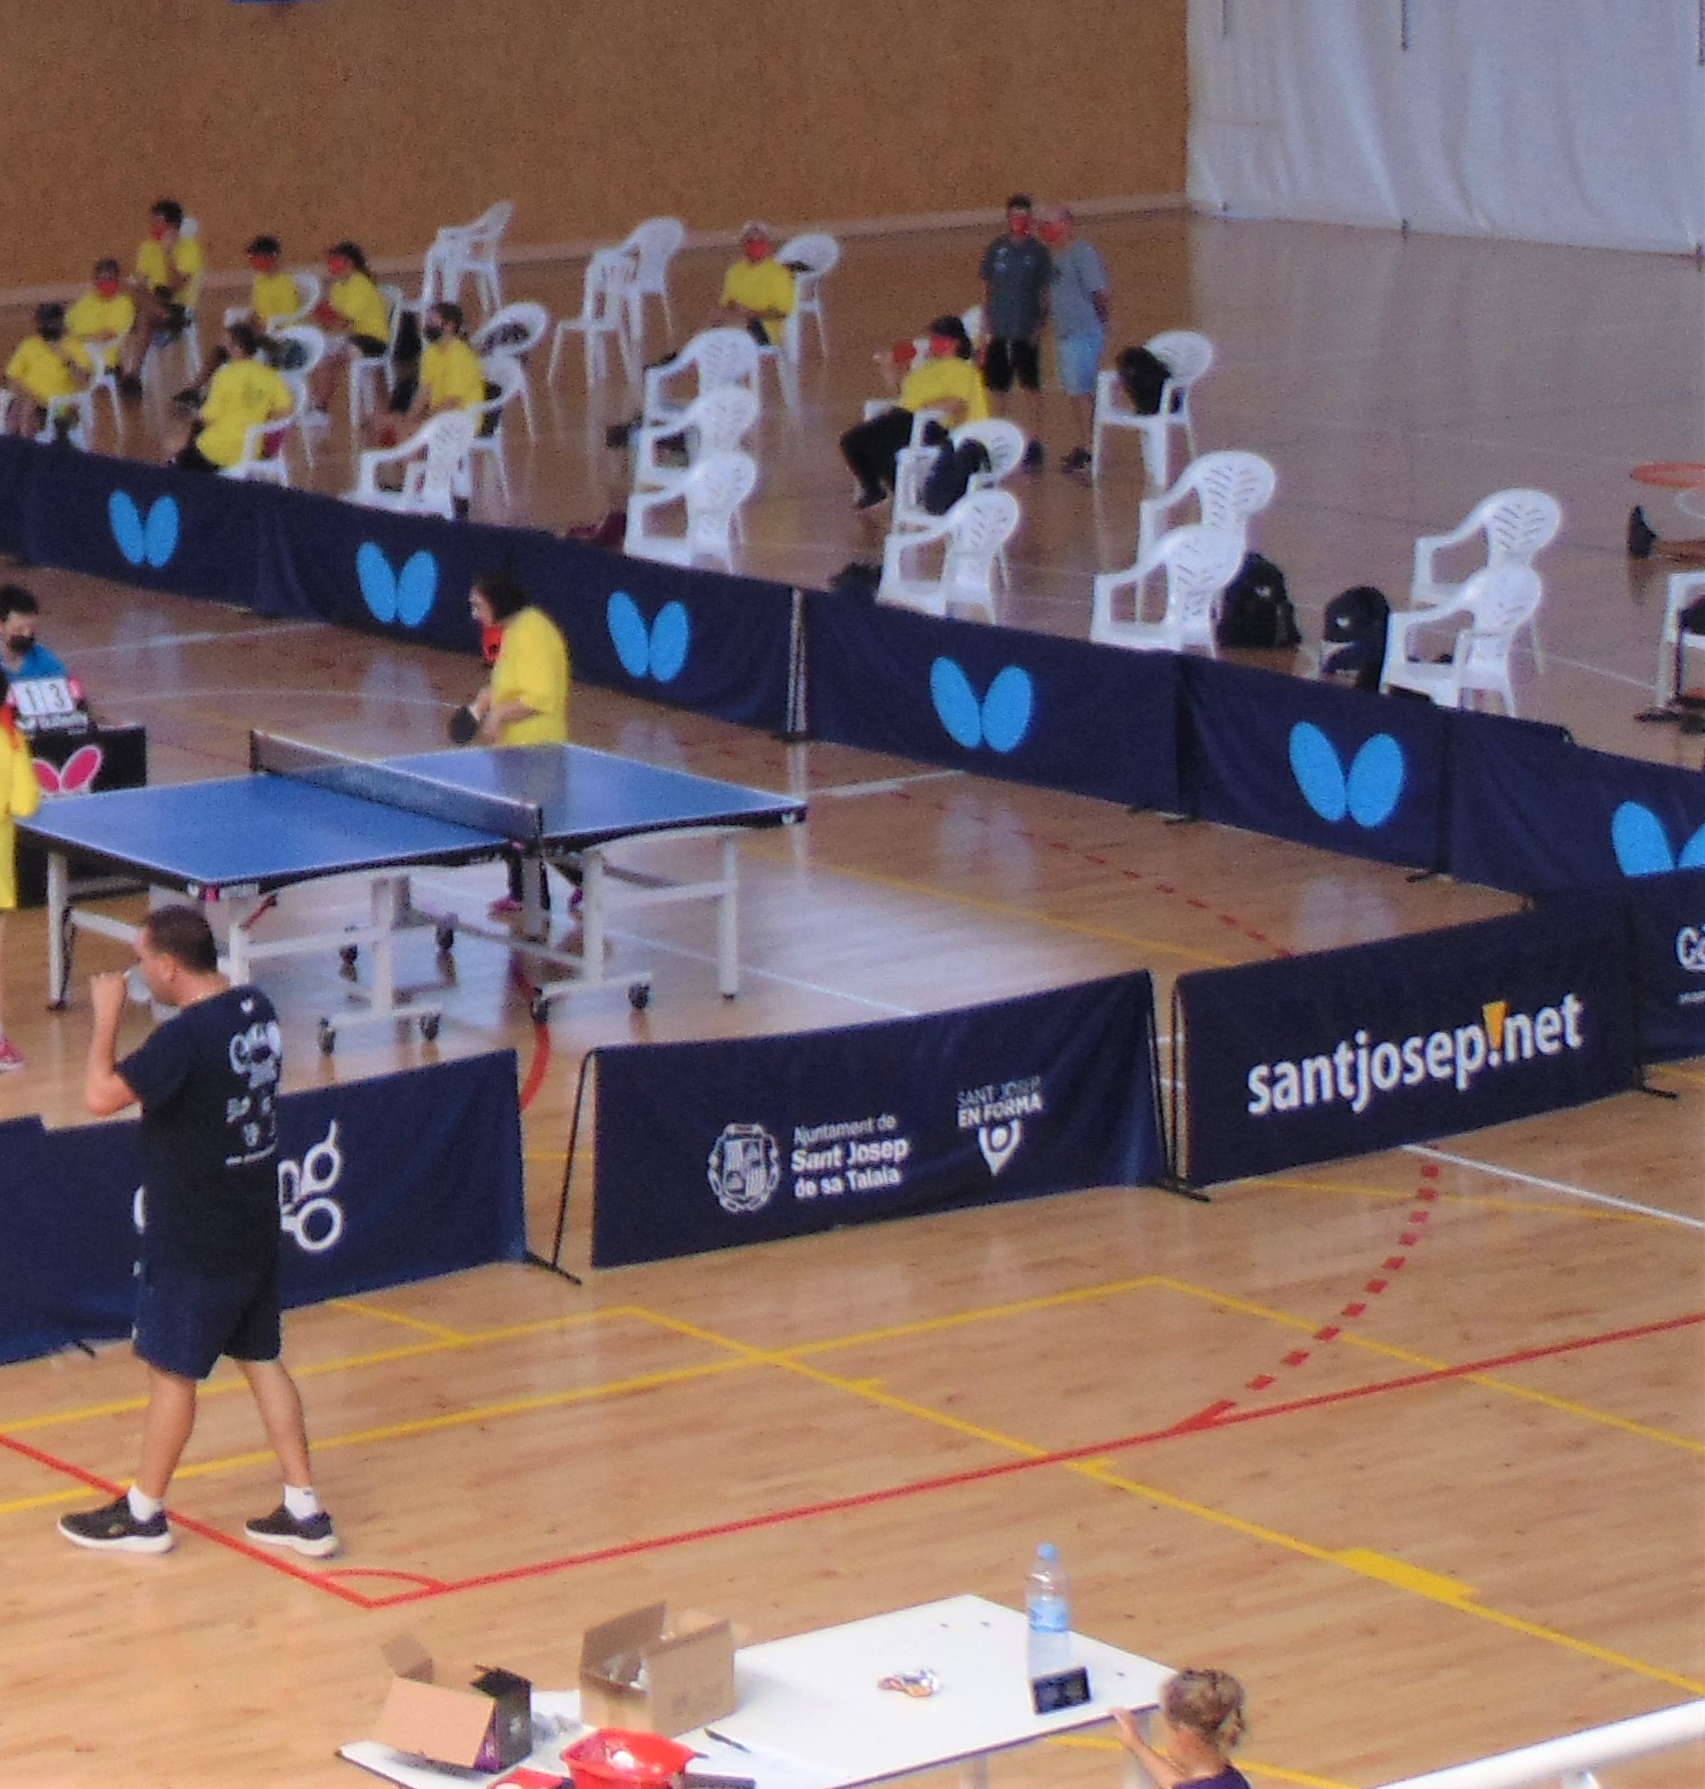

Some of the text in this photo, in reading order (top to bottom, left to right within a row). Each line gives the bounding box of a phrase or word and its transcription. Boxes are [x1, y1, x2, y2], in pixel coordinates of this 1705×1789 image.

[958, 1092, 1042, 1128] EN FORMA
[793, 1113, 897, 1147] Ajuntament de
[791, 1138, 909, 1172] Sant Josep
[794, 1177, 818, 1199] de
[820, 1176, 845, 1195] sa
